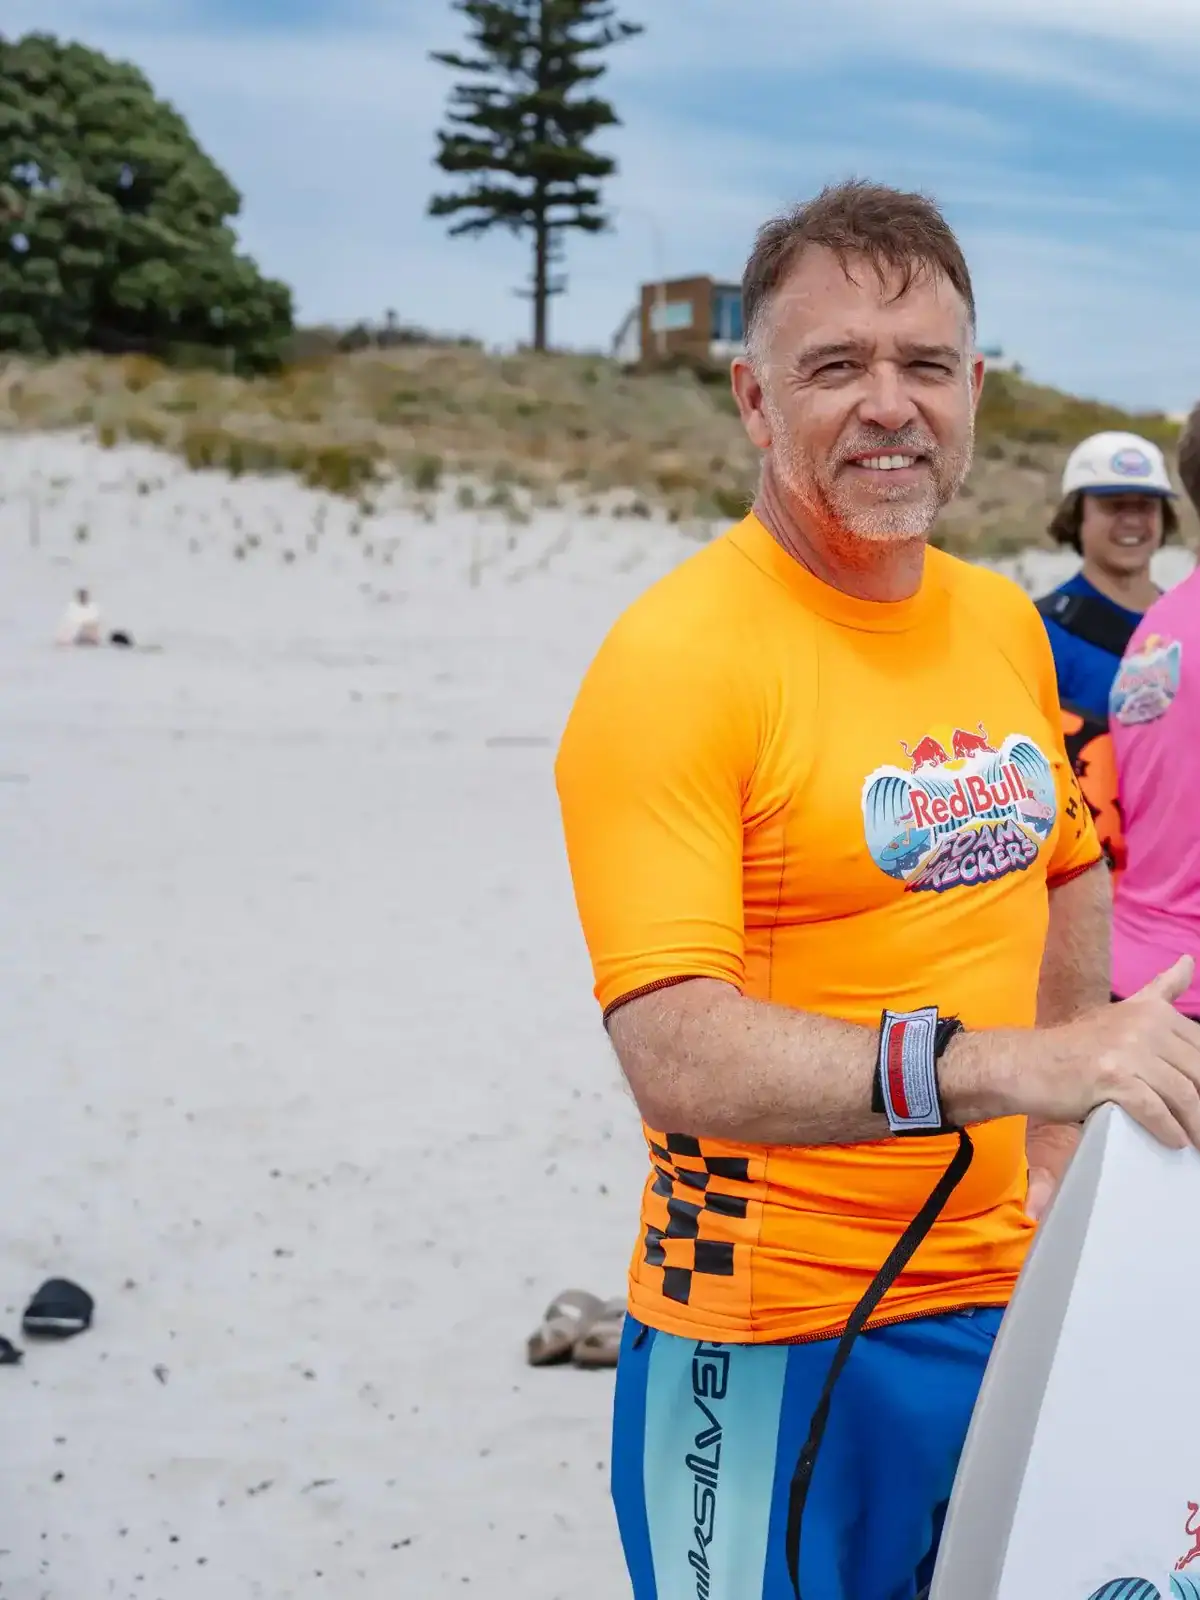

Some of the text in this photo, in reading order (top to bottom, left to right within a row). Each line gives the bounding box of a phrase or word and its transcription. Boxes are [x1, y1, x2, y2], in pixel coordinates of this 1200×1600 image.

[909, 778, 966, 829] Red
[966, 763, 1027, 812] Bull
[928, 819, 1028, 867] FOAM
